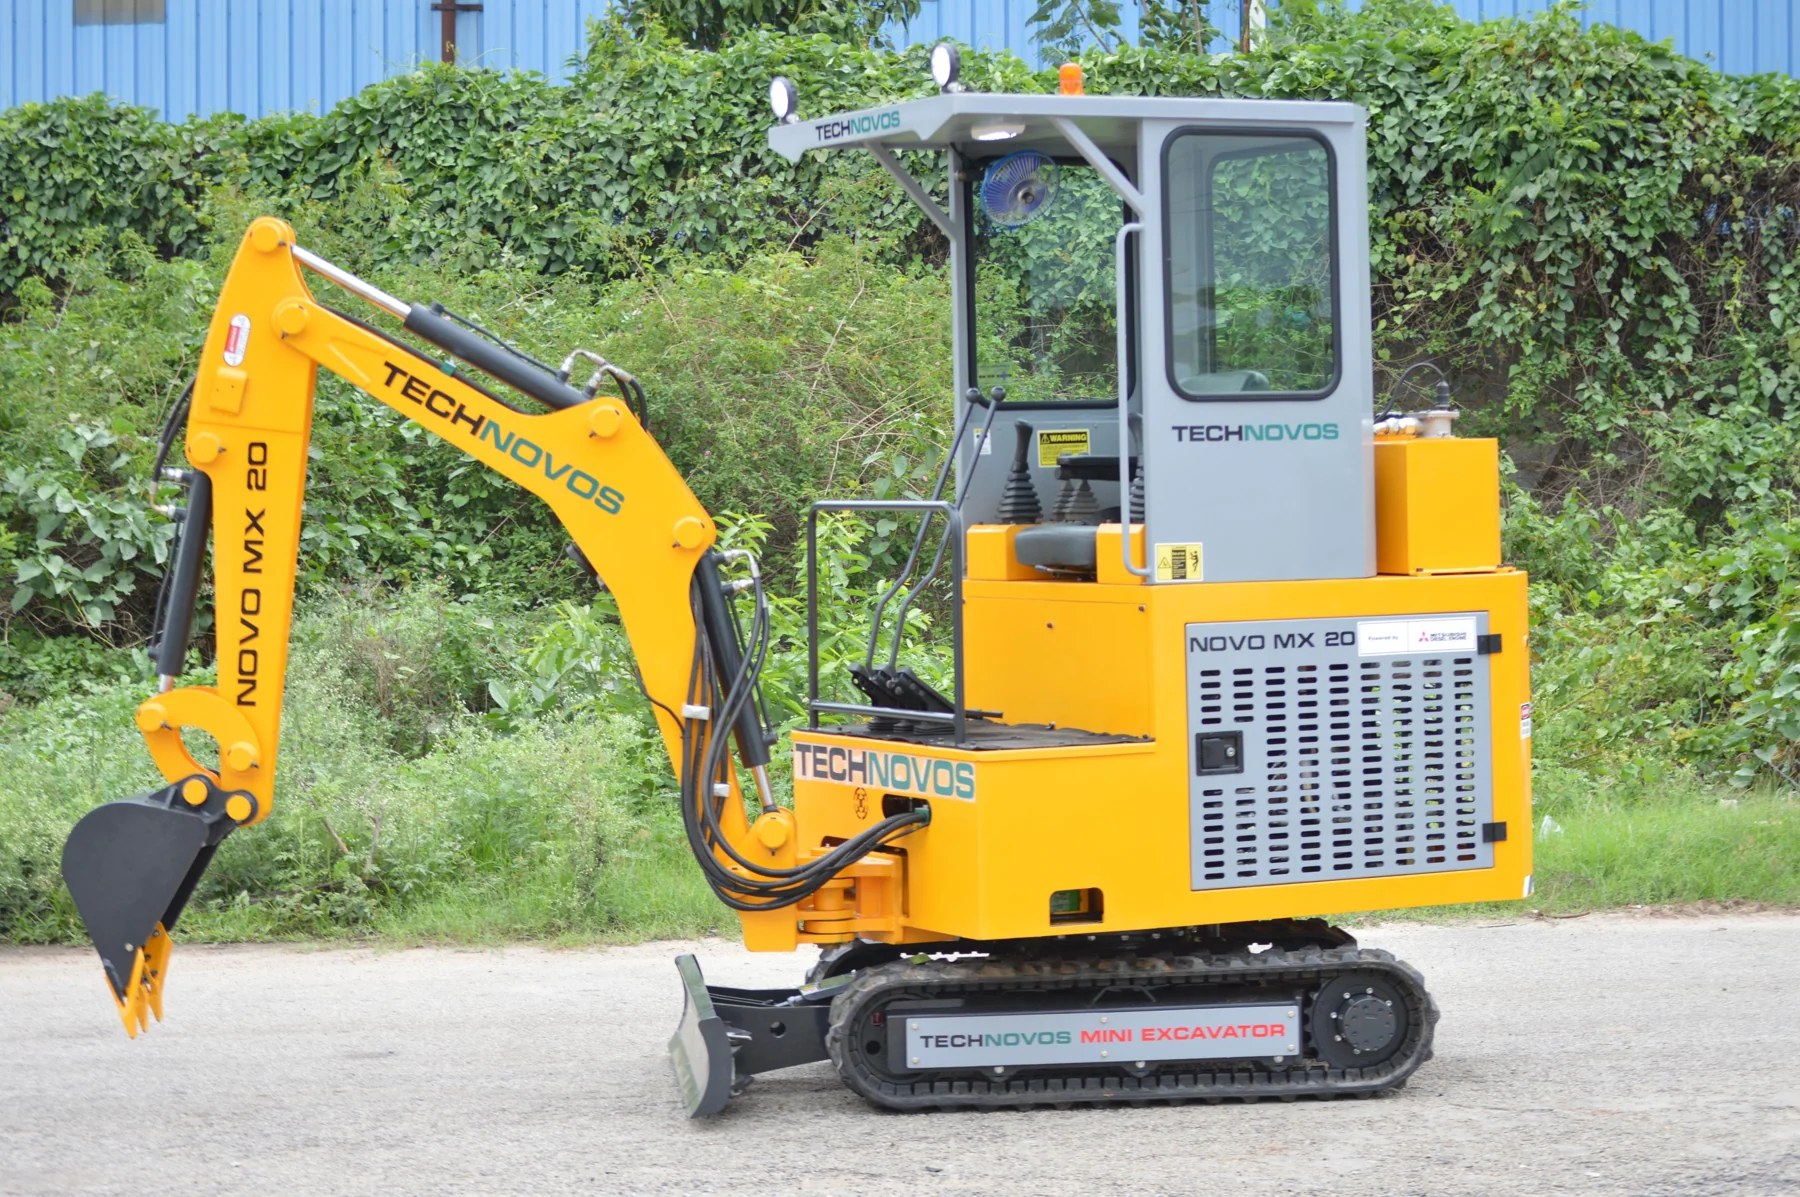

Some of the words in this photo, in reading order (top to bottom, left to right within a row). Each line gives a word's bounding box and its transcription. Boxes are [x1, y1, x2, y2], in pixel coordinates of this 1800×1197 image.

[815, 111, 900, 141] TECHNOVOS
[384, 361, 625, 515] TECHNOVOS
[1049, 433, 1087, 442] WARNING
[1171, 423, 1339, 442] TECHNOVOS
[247, 441, 268, 491] 20
[243, 508, 266, 574] MX
[237, 588, 261, 707] NOVO
[1190, 635, 1265, 652] NOVO
[1274, 632, 1315, 649] MX
[1325, 631, 1356, 647] 20
[795, 743, 974, 799] TECHNOVOS
[920, 1031, 1072, 1048] TECHNOVOS
[1080, 1029, 1133, 1044] MINI
[1141, 1024, 1286, 1042] EXCAVATOR
